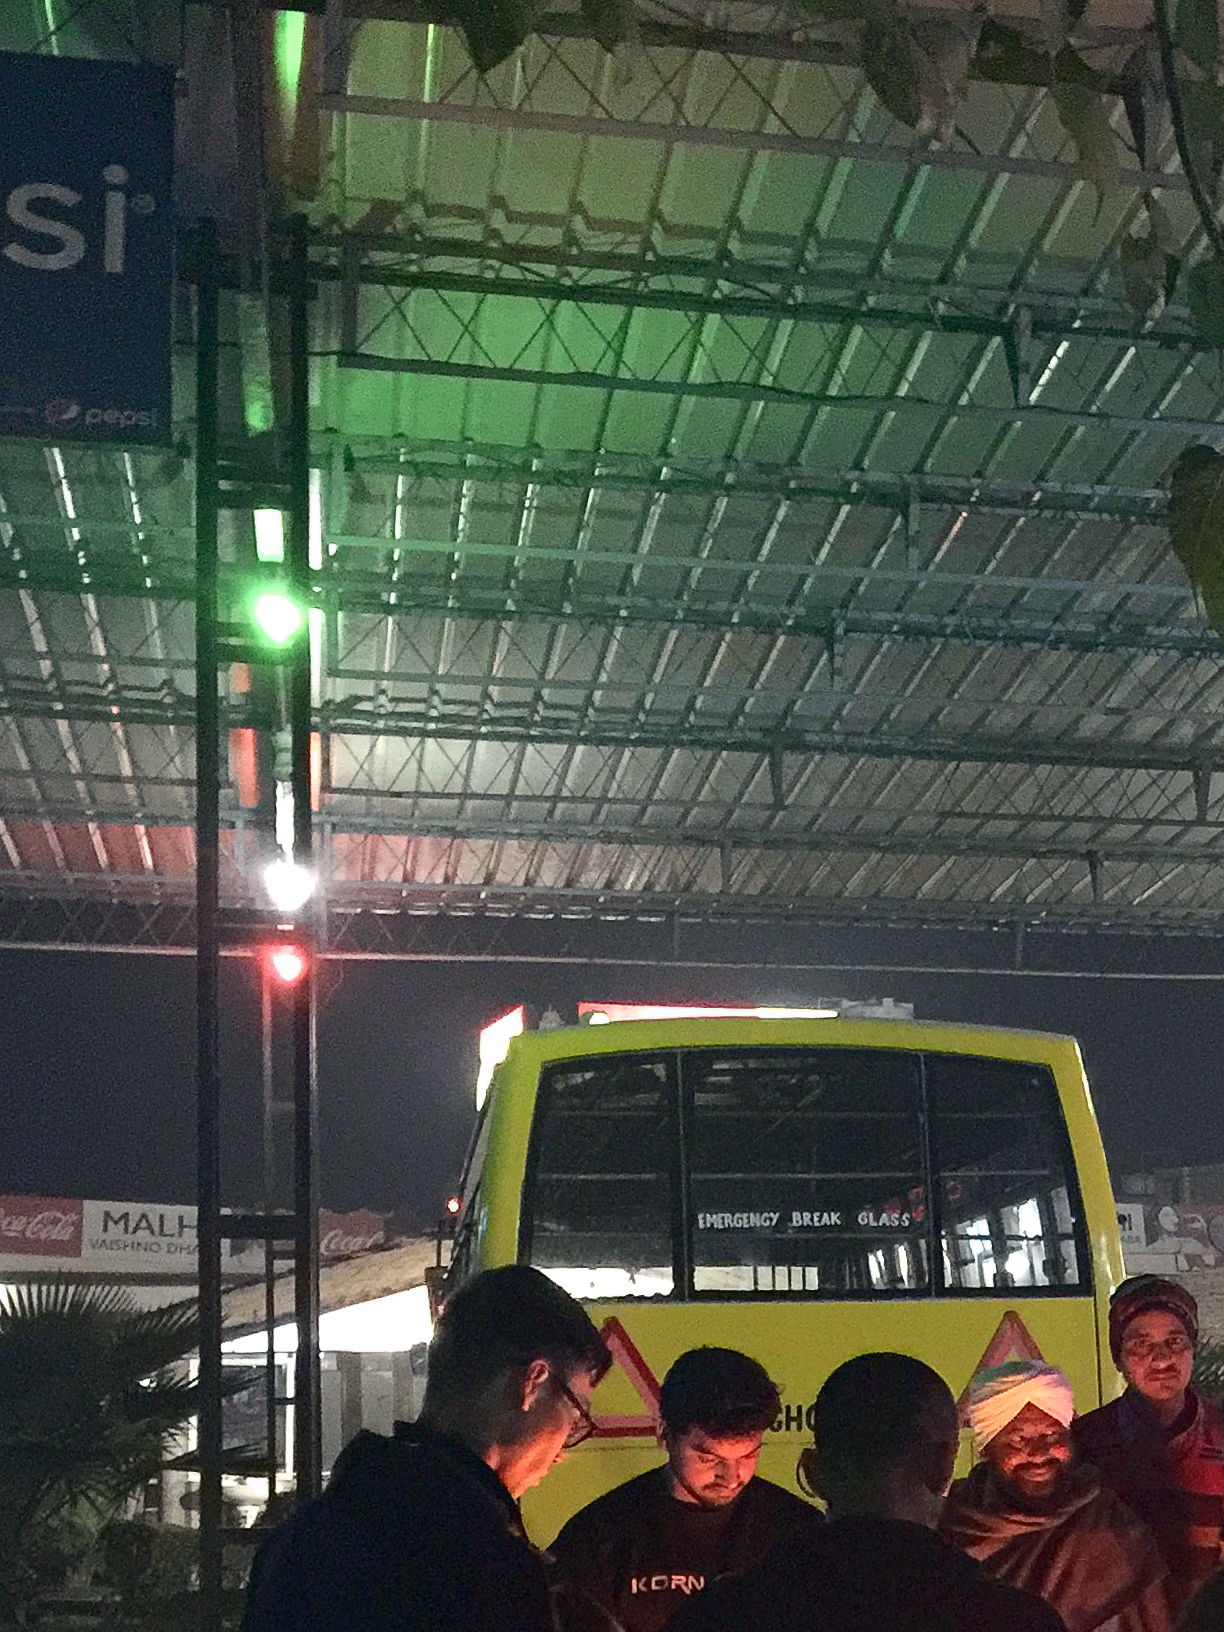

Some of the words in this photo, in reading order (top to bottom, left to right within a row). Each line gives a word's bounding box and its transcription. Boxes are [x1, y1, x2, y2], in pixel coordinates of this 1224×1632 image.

[698, 1211, 780, 1230] EMERGENCY
[792, 1211, 842, 1228] BREAK
[857, 1211, 910, 1227] GLASS
